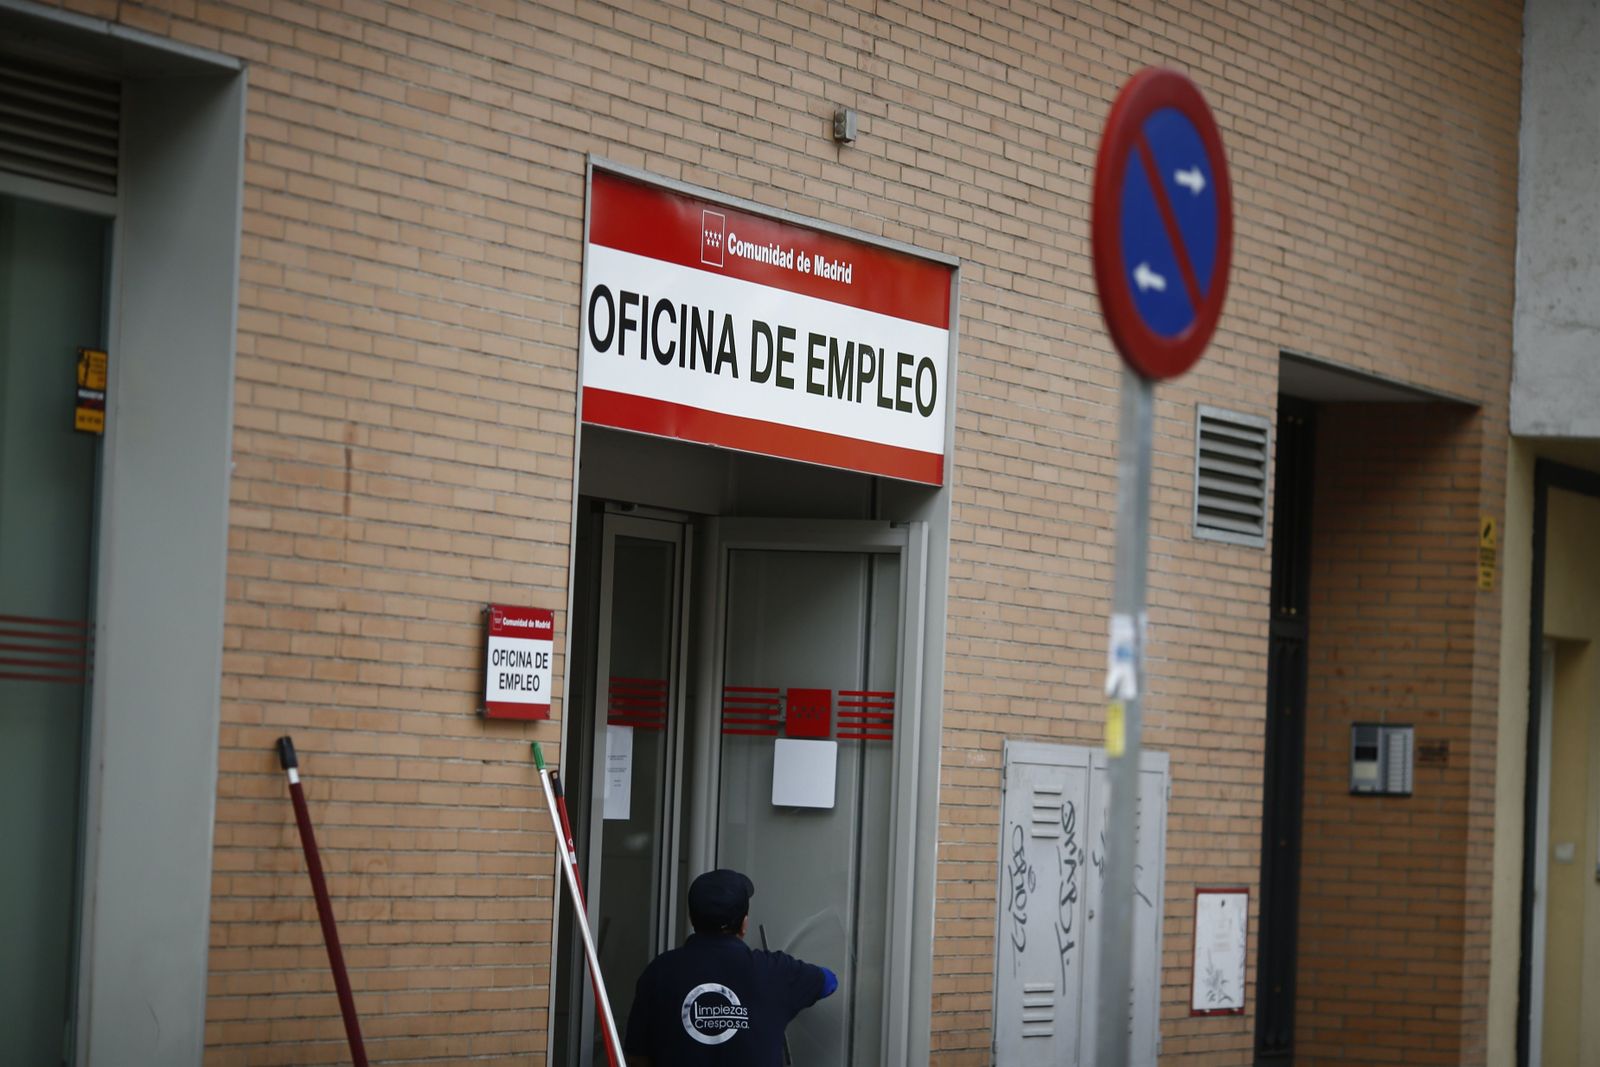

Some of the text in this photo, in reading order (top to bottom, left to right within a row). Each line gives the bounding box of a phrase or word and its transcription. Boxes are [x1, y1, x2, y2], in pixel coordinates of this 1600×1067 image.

[727, 232, 852, 284] Comunidad de Madrid
[588, 283, 938, 418] OFICINA DE EMPLEO
[503, 617, 551, 629] Comunidad de Madrid
[492, 648, 549, 669] OFICINA DE
[498, 673, 540, 692] EMPLEO
[694, 1001, 749, 1019] Limpiezas
